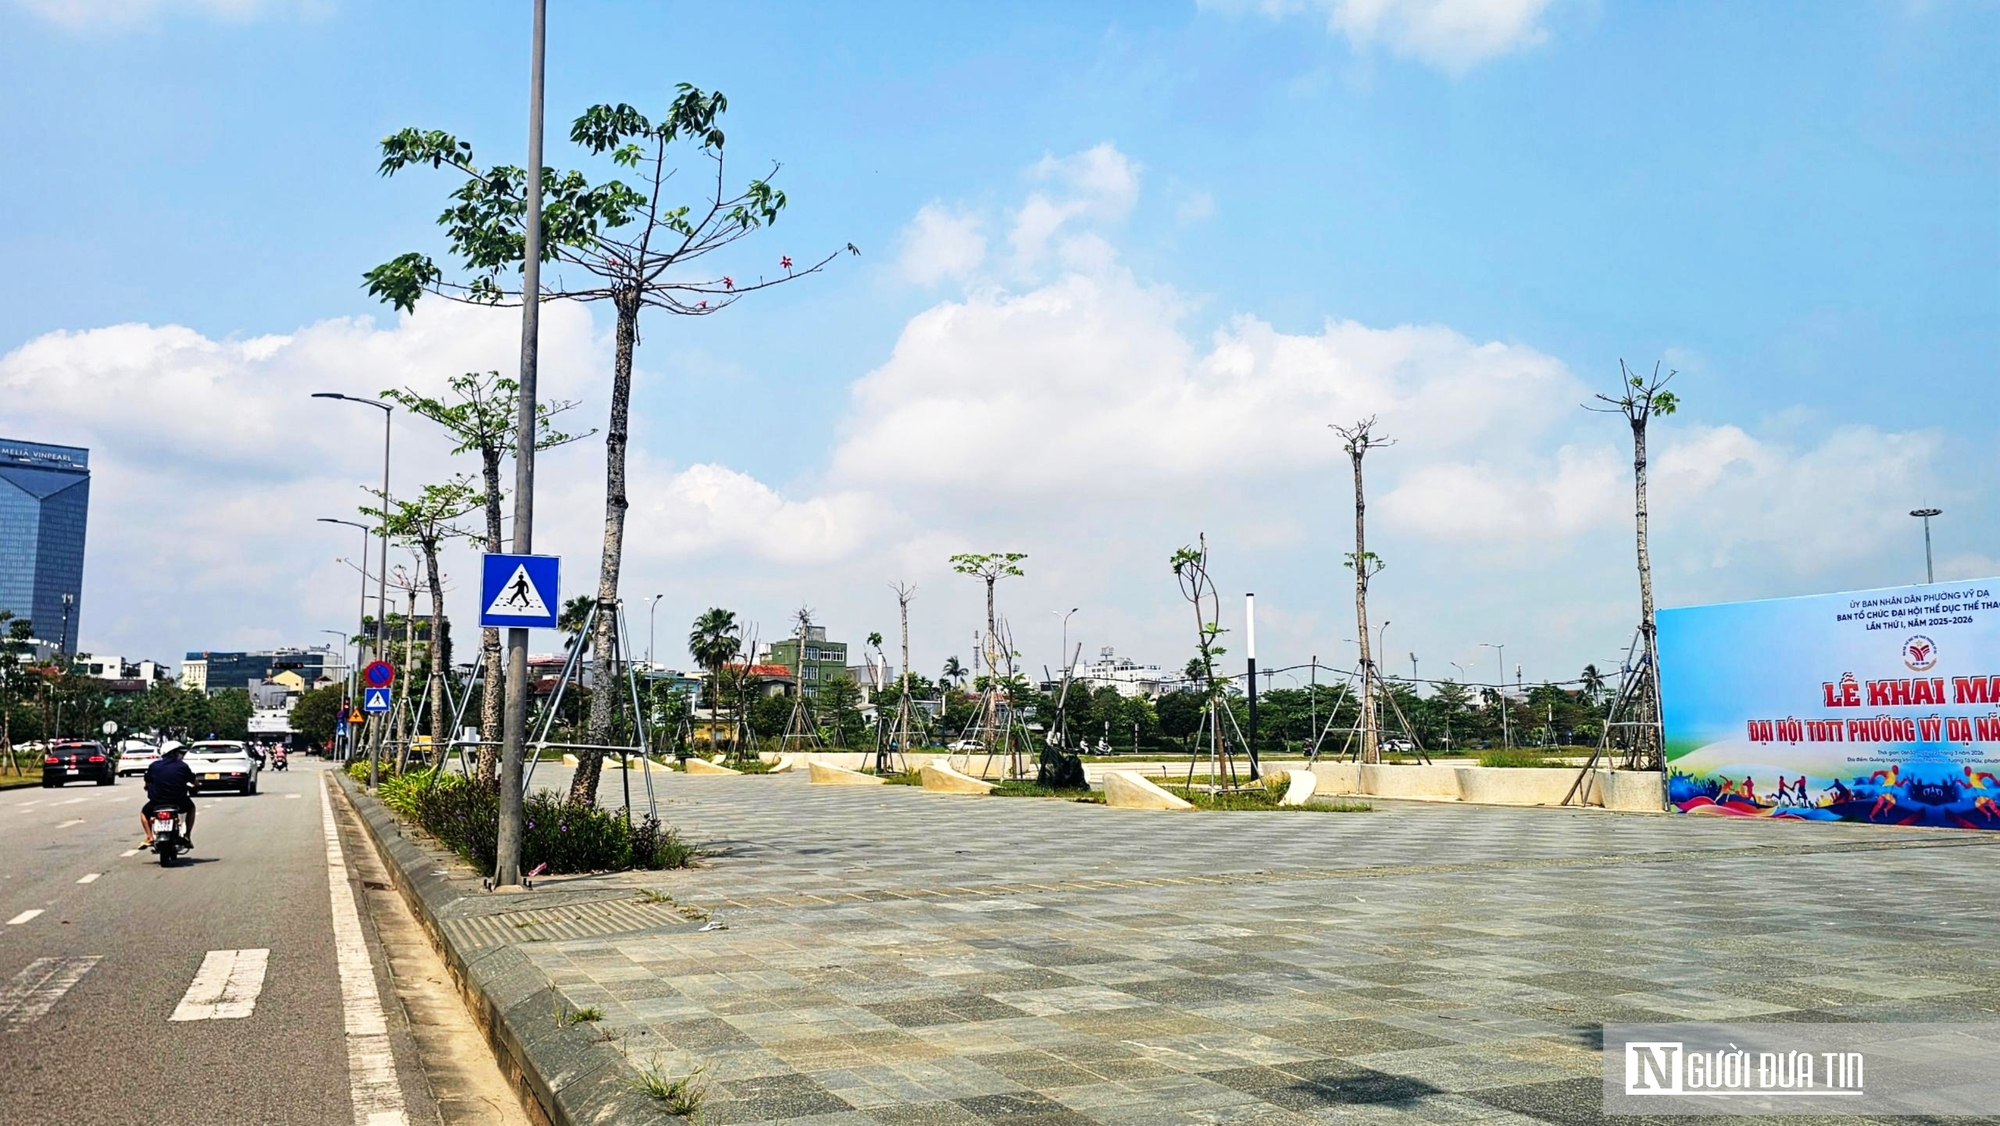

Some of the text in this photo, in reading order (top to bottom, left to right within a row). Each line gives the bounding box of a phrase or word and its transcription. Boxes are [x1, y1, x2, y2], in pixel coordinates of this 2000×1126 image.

[32, 450, 72, 462] VINPEARL
[1862, 599, 1878, 608] BAN
[1879, 595, 1902, 607] NHÂN
[1904, 594, 1922, 605] DÂN
[1923, 590, 1962, 602] PHƯỜNG
[1962, 588, 1975, 599] VỸ
[1976, 589, 1990, 599] DẠ
[1836, 612, 1853, 622] BAN
[1866, 608, 1890, 619] CHỨC
[1891, 607, 1906, 618] ĐẠI
[1907, 605, 1923, 617] HỘI
[1942, 603, 1961, 615] DỤC
[1981, 600, 2000, 610] THA
[1908, 616, 1927, 628] NĂM
[1928, 615, 1974, 627] 2025-2026
[1822, 672, 1861, 707] LỄ
[1866, 677, 1946, 706] KHAI
[1747, 719, 1774, 746] ĐẠI
[1776, 715, 1804, 746] HỘI
[1805, 718, 1844, 742] TDTT
[1847, 713, 1916, 742] PHƯỜNG
[1918, 713, 1942, 742] VỸ
[1945, 717, 1973, 746] DẠ
